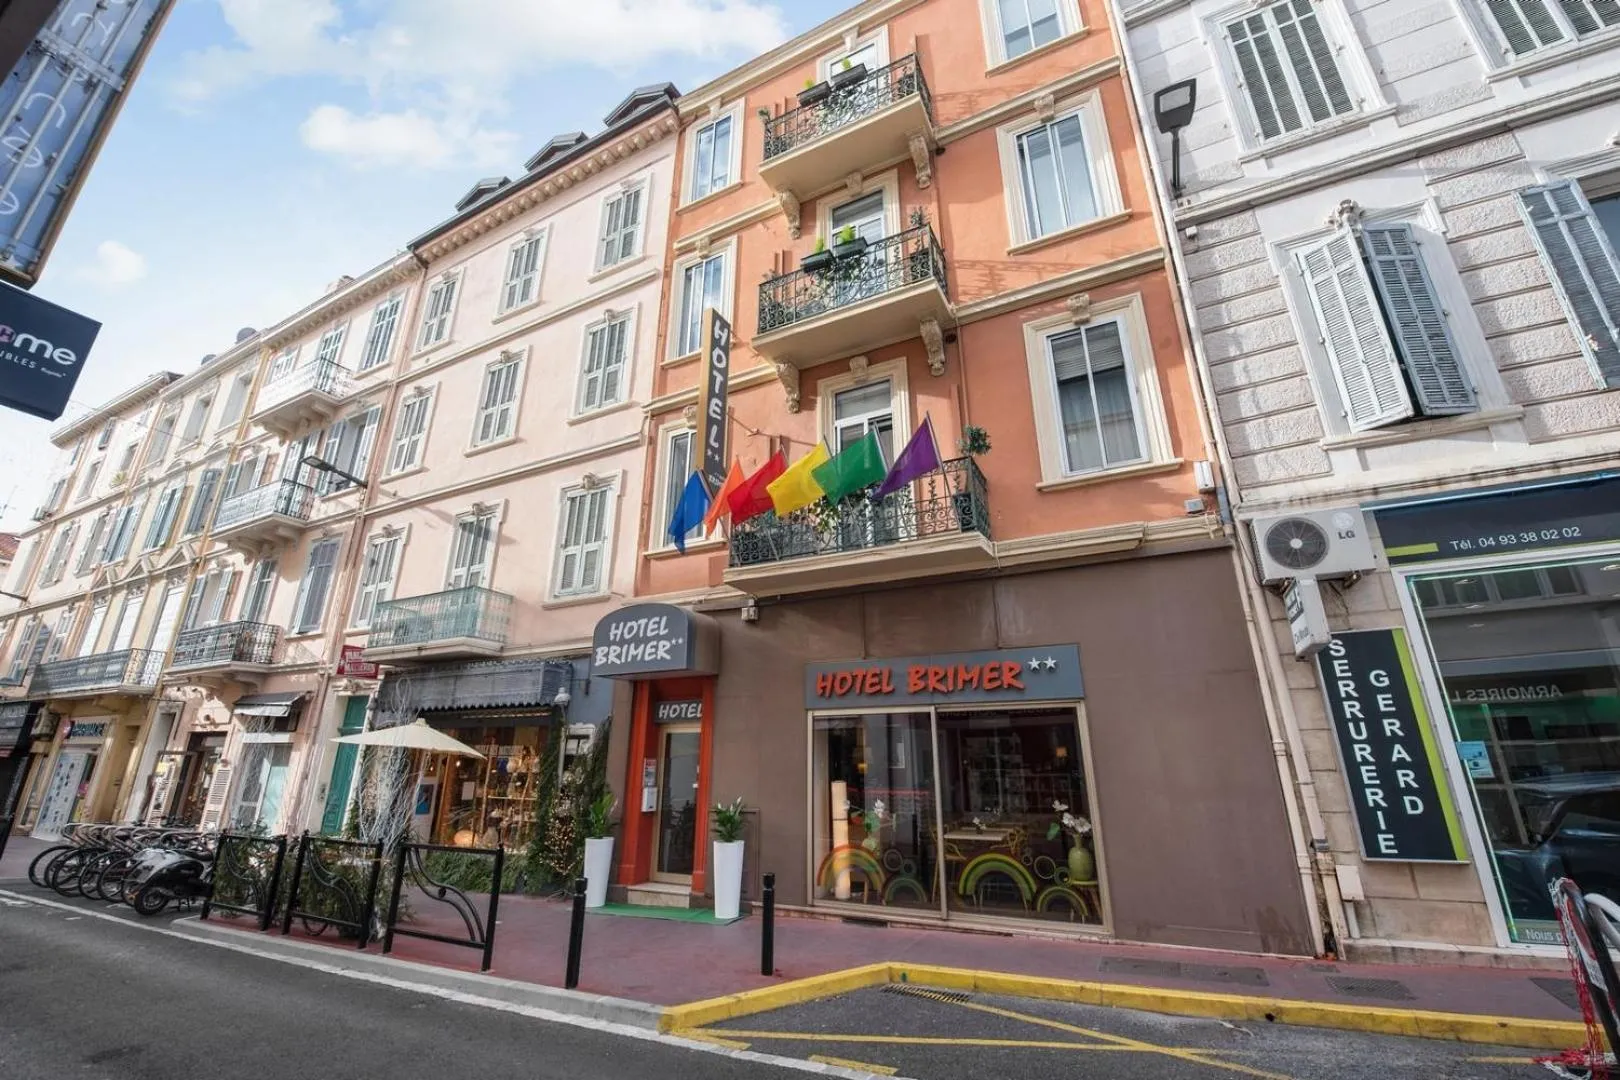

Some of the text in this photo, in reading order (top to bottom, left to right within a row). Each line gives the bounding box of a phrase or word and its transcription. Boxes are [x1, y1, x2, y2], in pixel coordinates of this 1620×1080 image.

[708, 319, 729, 449] HOTEL
[1337, 530, 1356, 540] LG
[1479, 537, 1496, 548] 04
[1498, 534, 1517, 545] 93
[1520, 531, 1538, 543] 38
[1540, 529, 1560, 540] 02
[1562, 526, 1582, 538] 02
[609, 616, 669, 642] HOTEL
[816, 660, 1025, 698] HOTEL BRIMER
[658, 703, 703, 719] HOTEL
[1328, 639, 1398, 854] SERRURERIE
[1369, 669, 1425, 815] GERARD
